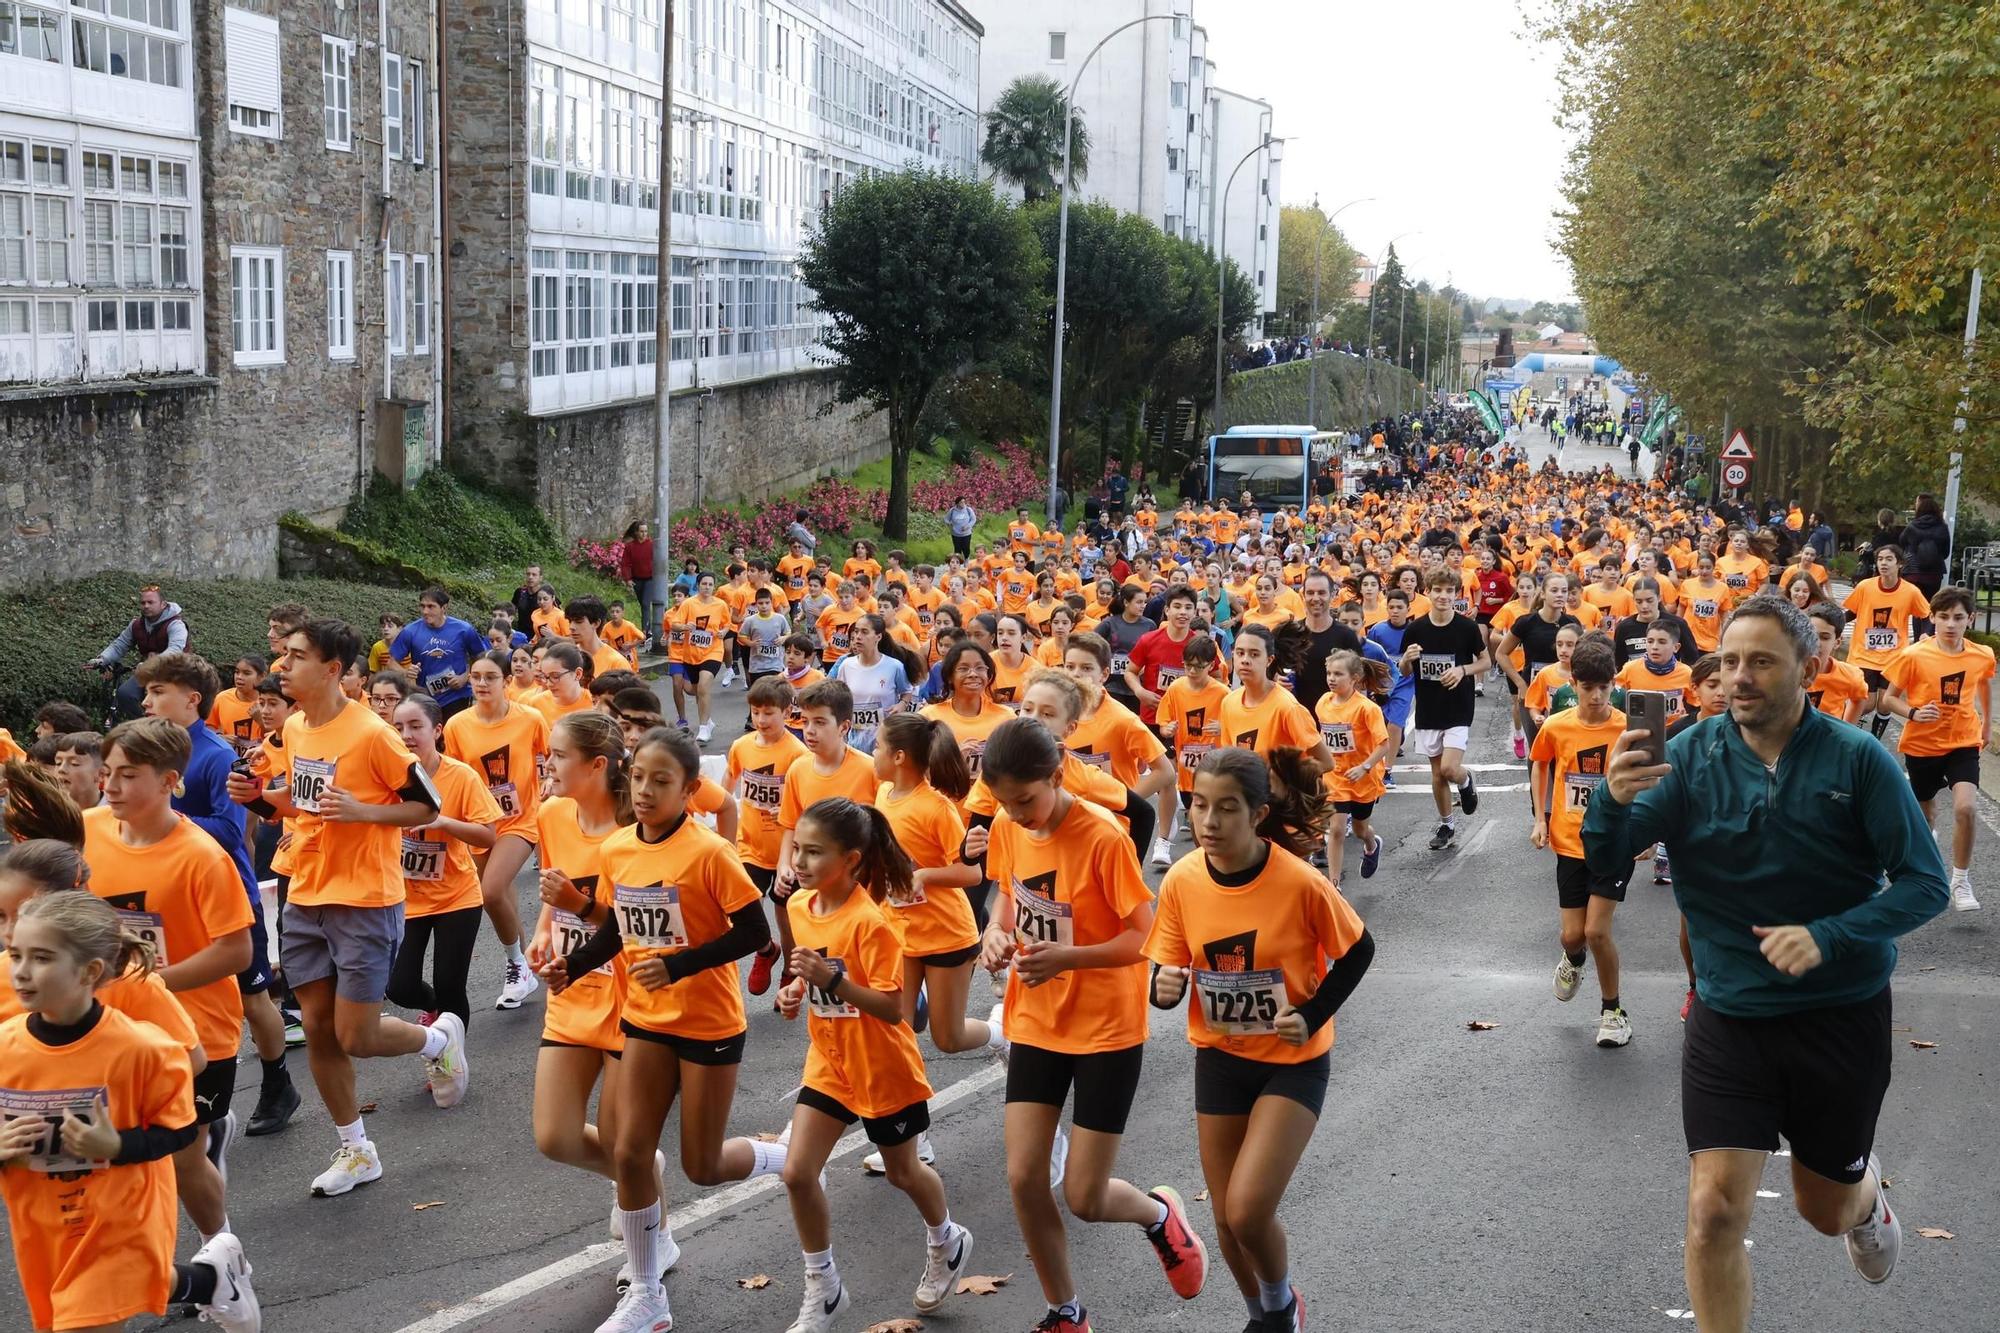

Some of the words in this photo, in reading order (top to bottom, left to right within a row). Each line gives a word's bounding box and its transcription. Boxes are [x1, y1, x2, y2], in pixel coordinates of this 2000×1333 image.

[1729, 470, 1744, 480] 30
[690, 633, 711, 646] 4300
[1869, 634, 1893, 646] 5212
[760, 645, 778, 656] 7516
[744, 780, 780, 804] 7255
[620, 906, 674, 938] 7372
[1015, 898, 1058, 943] 7211
[1233, 944, 1246, 956] 45
[1205, 989, 1278, 1023] 7225
